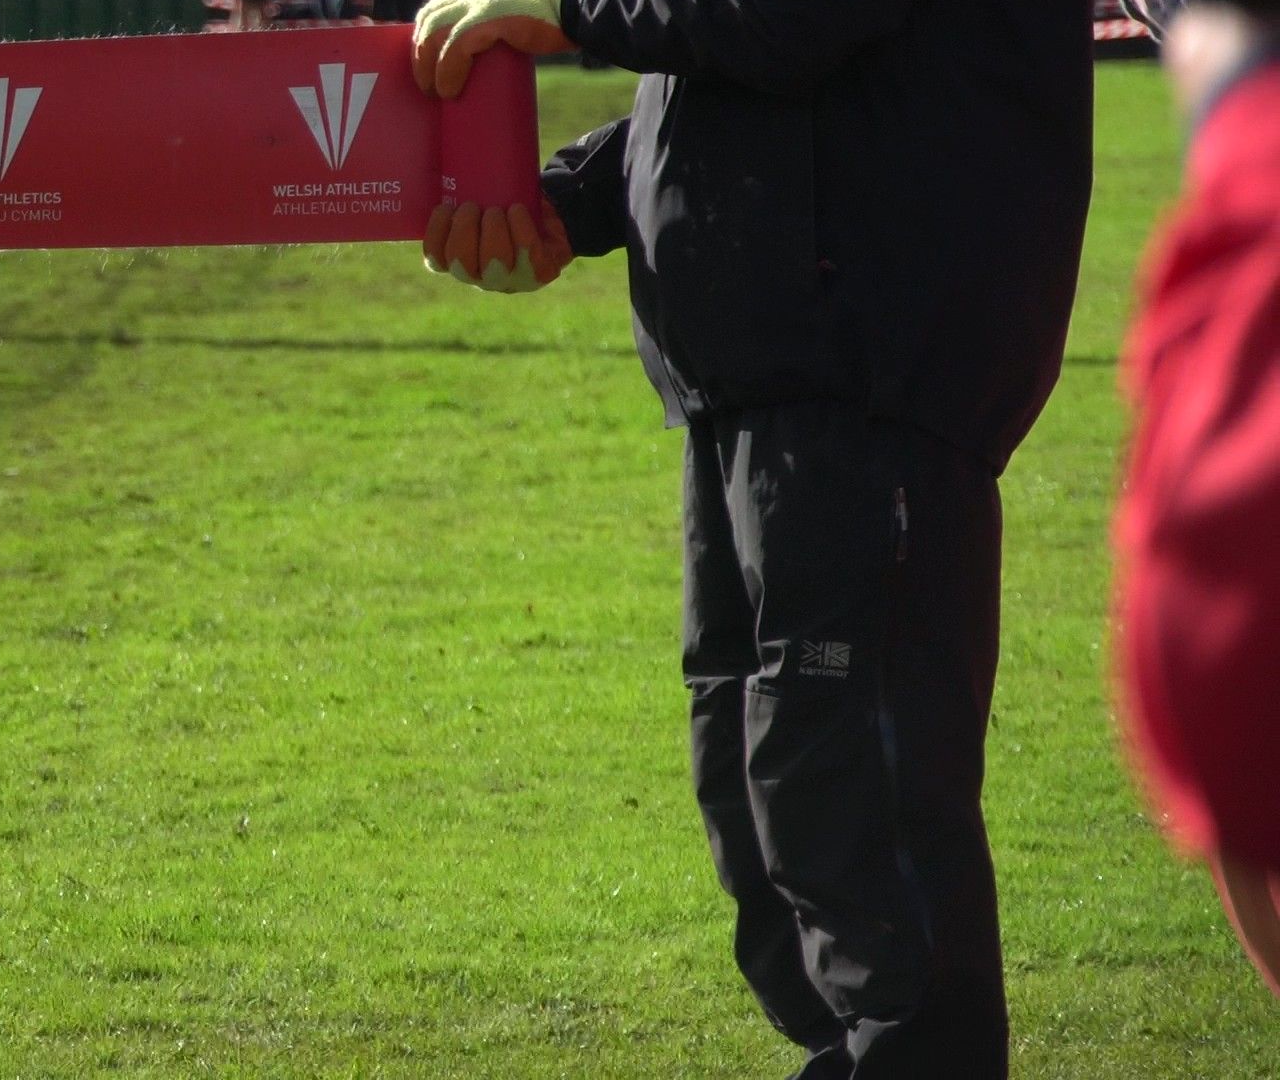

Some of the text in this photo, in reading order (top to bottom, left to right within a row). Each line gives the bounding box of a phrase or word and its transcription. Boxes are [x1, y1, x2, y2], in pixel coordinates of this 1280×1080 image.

[273, 181, 401, 197] WELSH ATHLETICS
[273, 200, 401, 215] ATHLETAU CYMRU
[11, 209, 62, 222] CYMRU
